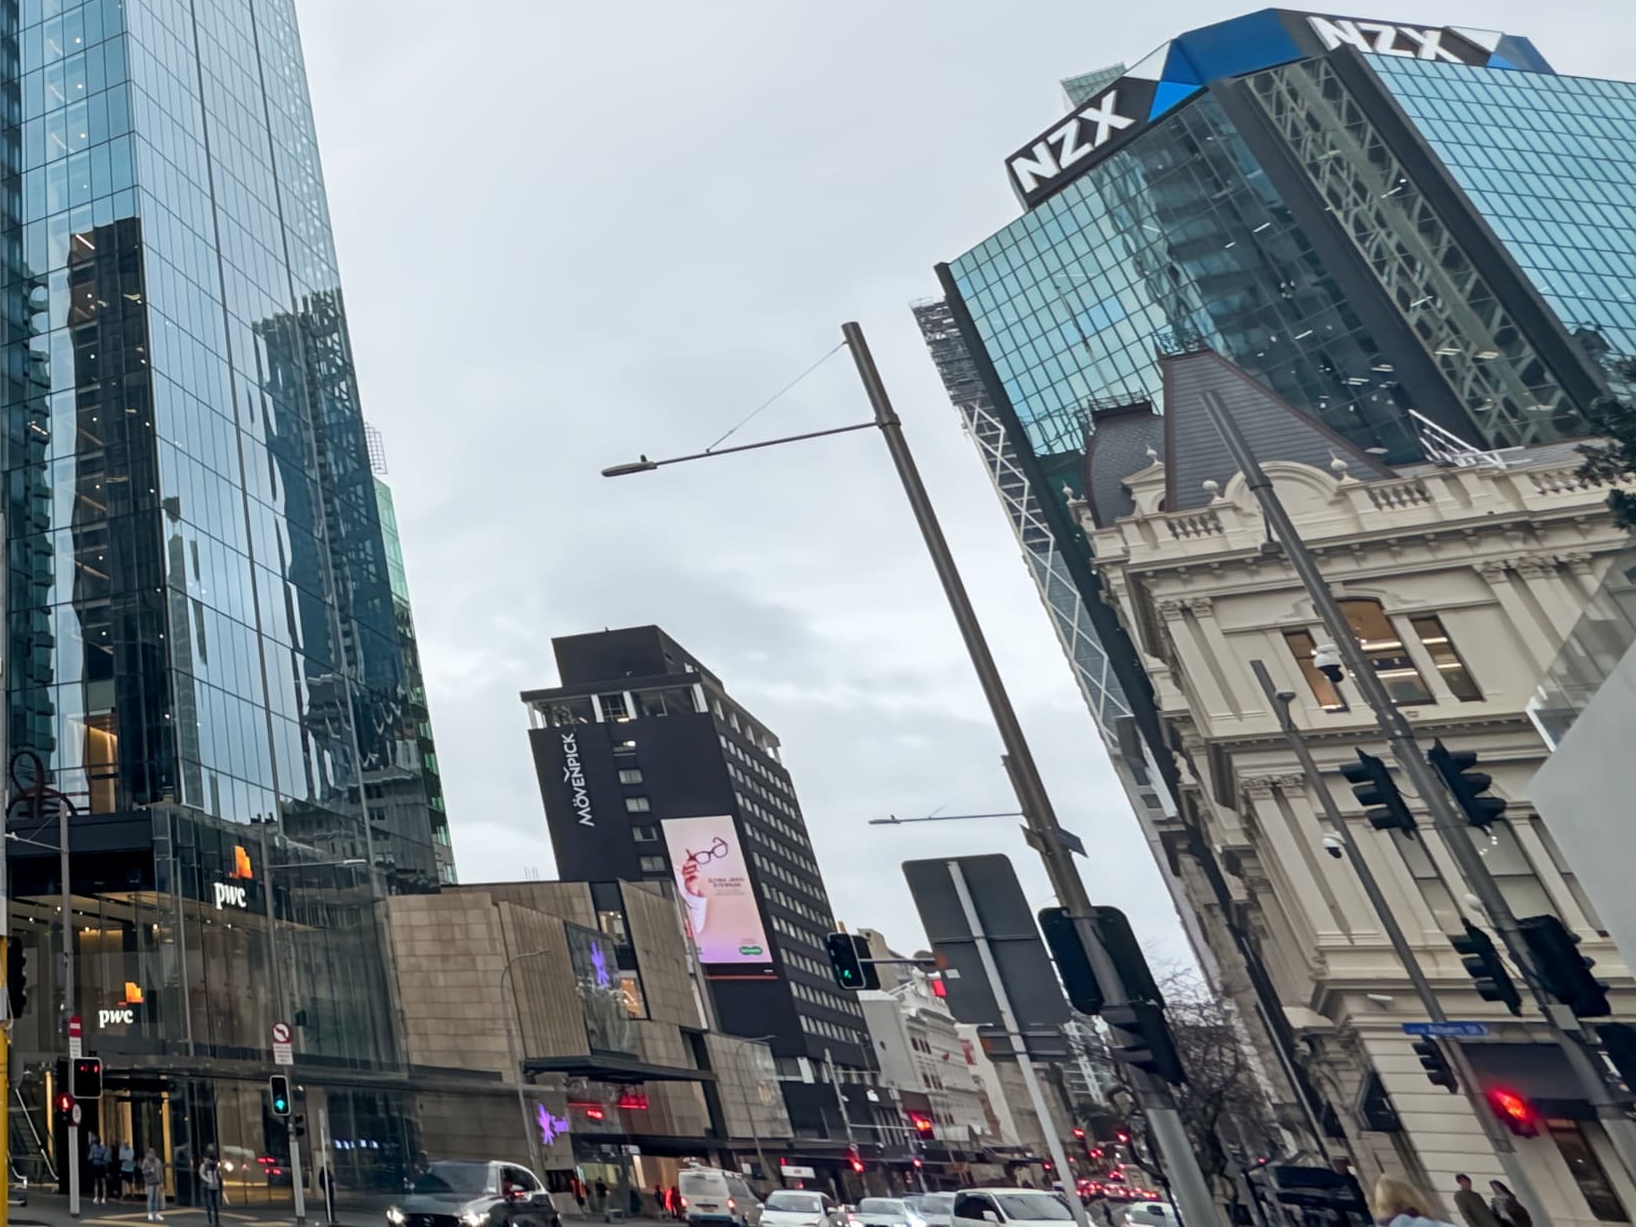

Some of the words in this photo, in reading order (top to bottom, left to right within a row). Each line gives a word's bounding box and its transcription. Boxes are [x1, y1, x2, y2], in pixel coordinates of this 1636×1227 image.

[1305, 15, 1465, 64] NZX
[1011, 89, 1136, 194] NZX
[561, 732, 596, 827] MÖVENPICK
[213, 882, 247, 910] pwc
[98, 1010, 134, 1028] pwc
